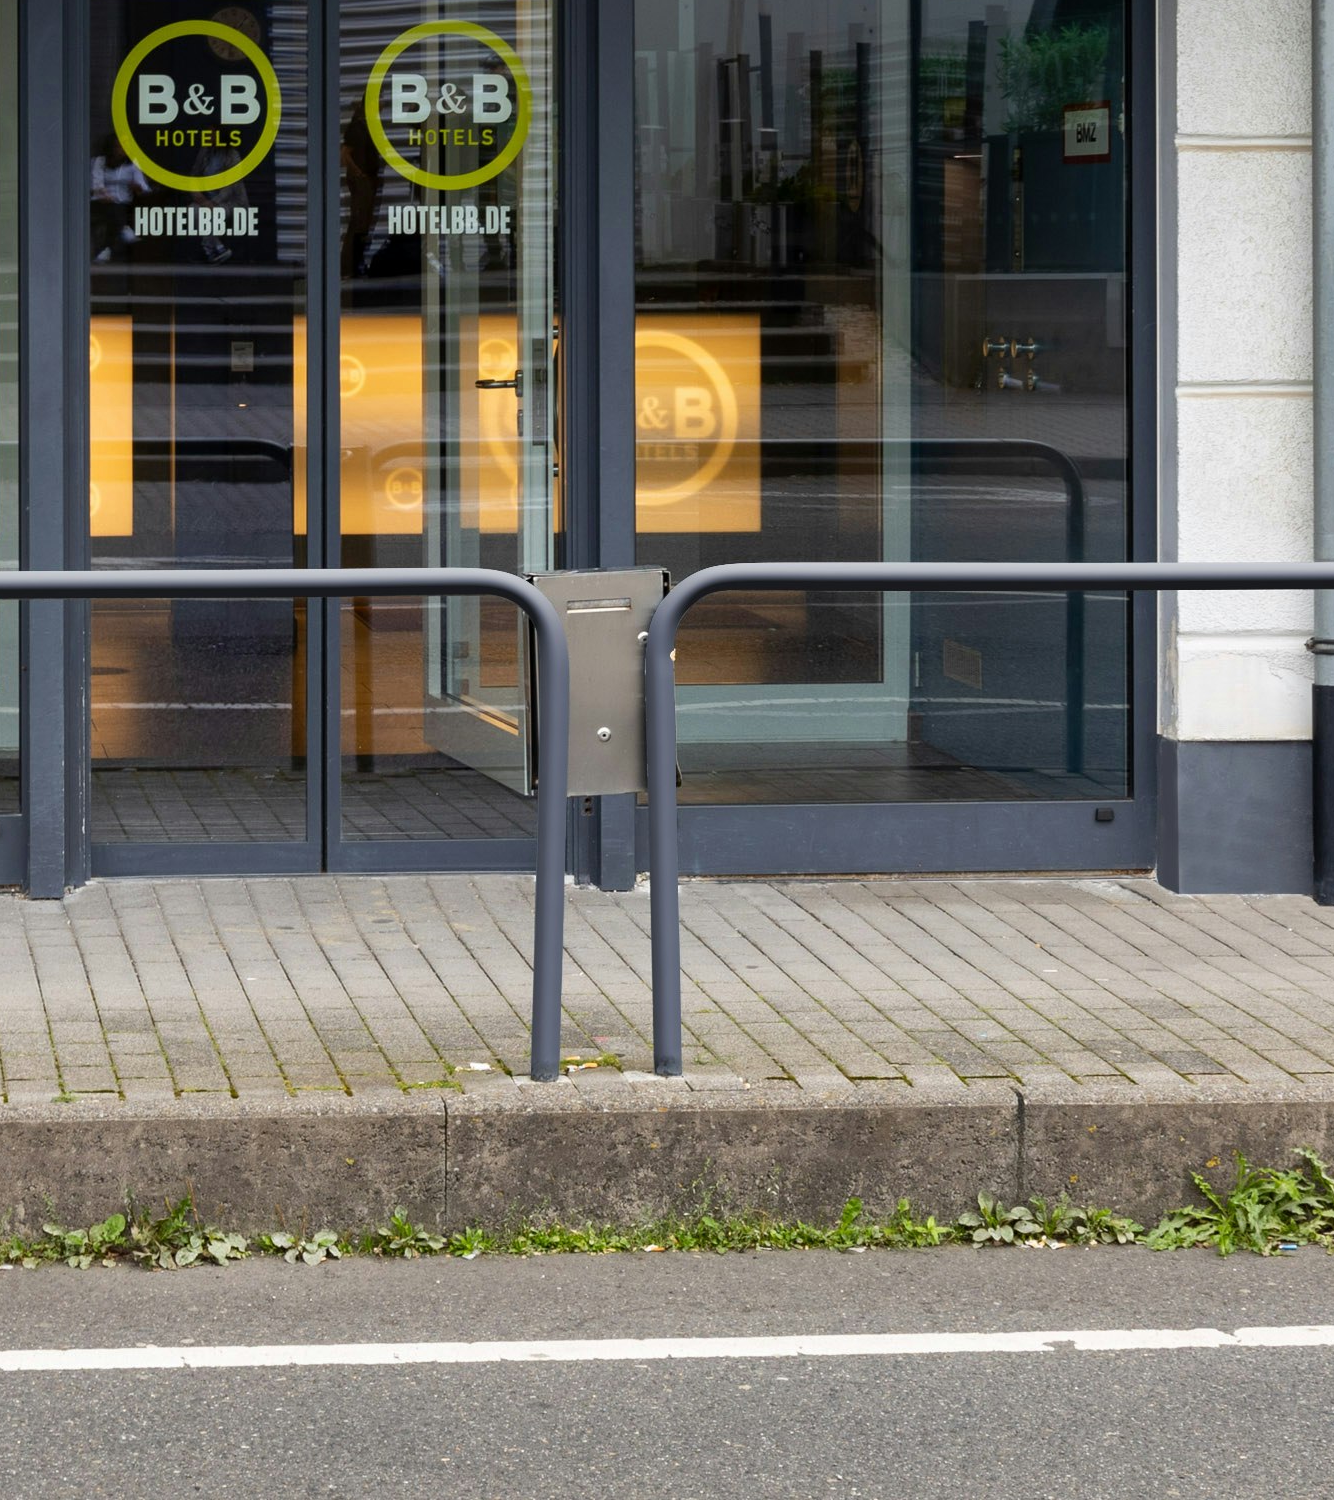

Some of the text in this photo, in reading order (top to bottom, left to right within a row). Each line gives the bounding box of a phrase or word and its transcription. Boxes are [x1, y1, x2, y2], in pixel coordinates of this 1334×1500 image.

[138, 74, 261, 125] B&B
[391, 73, 512, 124] B&B
[156, 129, 242, 147] HOTELS
[409, 128, 494, 146] HOTELS
[1076, 122, 1097, 143] BMZ
[135, 207, 259, 236] HOTELBB.DE
[388, 205, 510, 235] HOTELBB.DE
[636, 387, 716, 438] &B
